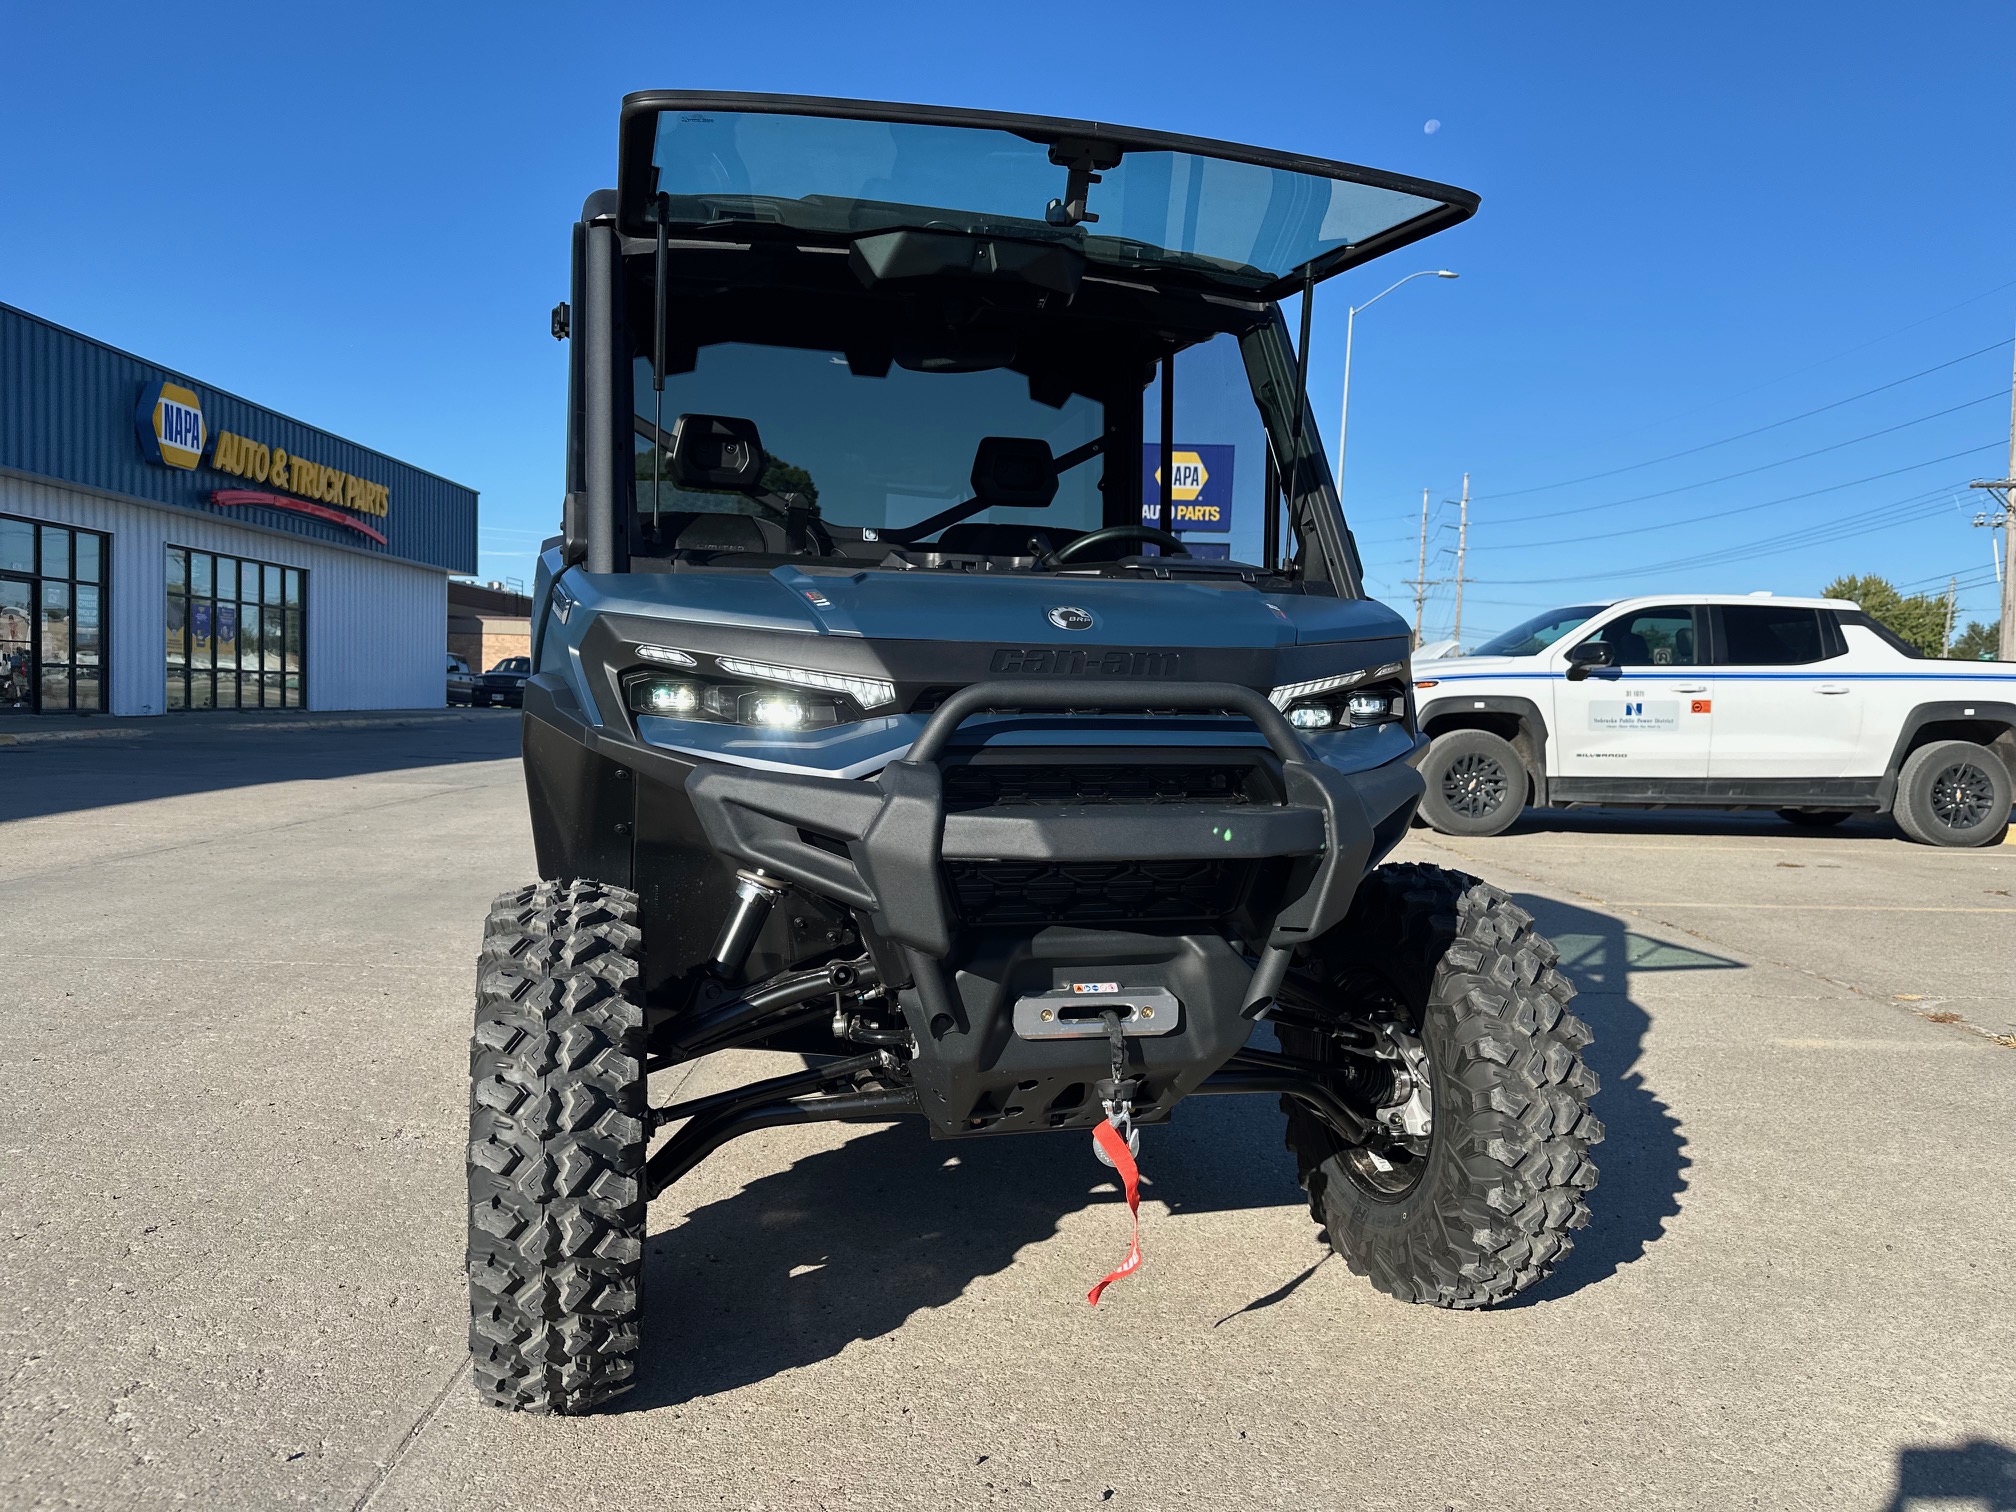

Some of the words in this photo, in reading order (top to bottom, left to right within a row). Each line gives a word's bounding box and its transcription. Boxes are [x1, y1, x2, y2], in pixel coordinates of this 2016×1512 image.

[163, 402, 200, 450] NAPA
[213, 430, 271, 483] AUTO
[269, 447, 289, 490] &
[289, 455, 346, 503] TRUCK
[342, 470, 390, 518] PARTS
[1172, 465, 1199, 487] APA
[1142, 504, 1175, 520] AU
[1177, 505, 1220, 522] PARTS
[989, 648, 1182, 678] can-am
